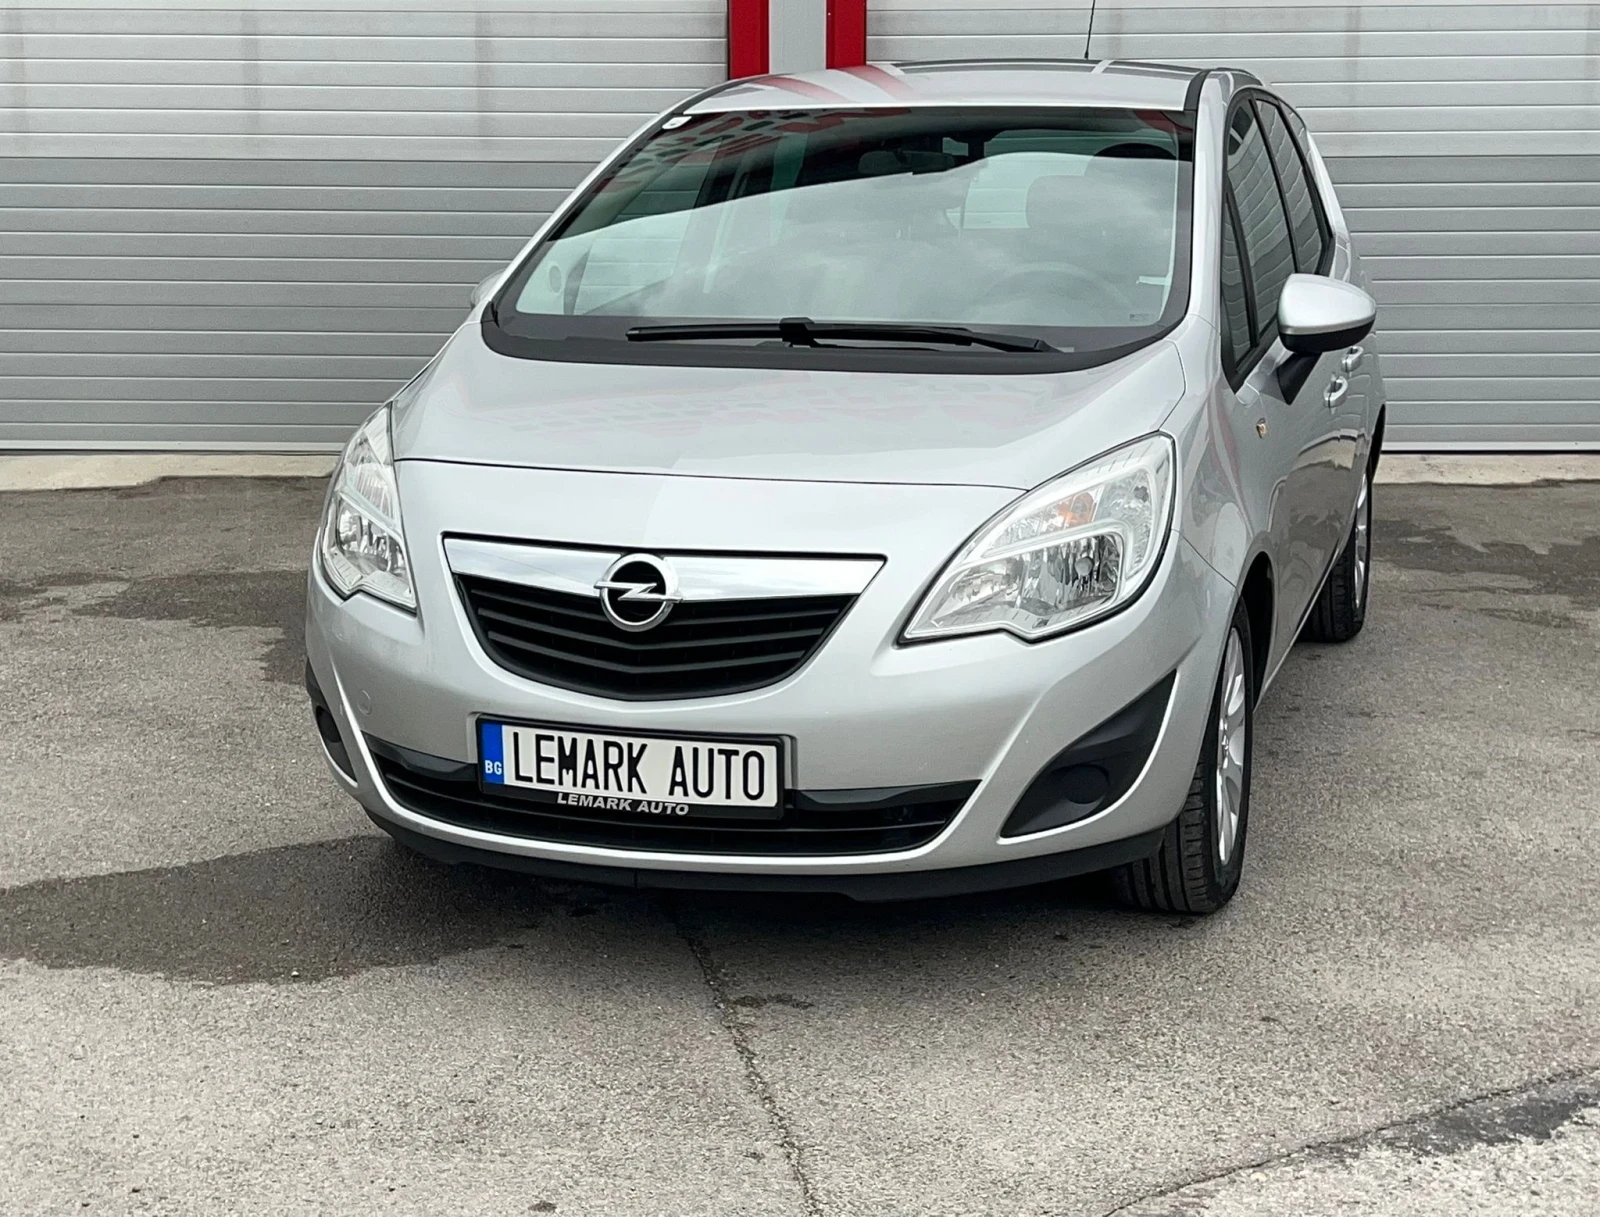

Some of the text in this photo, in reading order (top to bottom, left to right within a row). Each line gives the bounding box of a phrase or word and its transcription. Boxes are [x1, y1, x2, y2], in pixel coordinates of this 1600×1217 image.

[485, 760, 502, 774] BG
[513, 731, 765, 800] LEMARK AUTO
[557, 793, 689, 815] LEMARK AUTO
